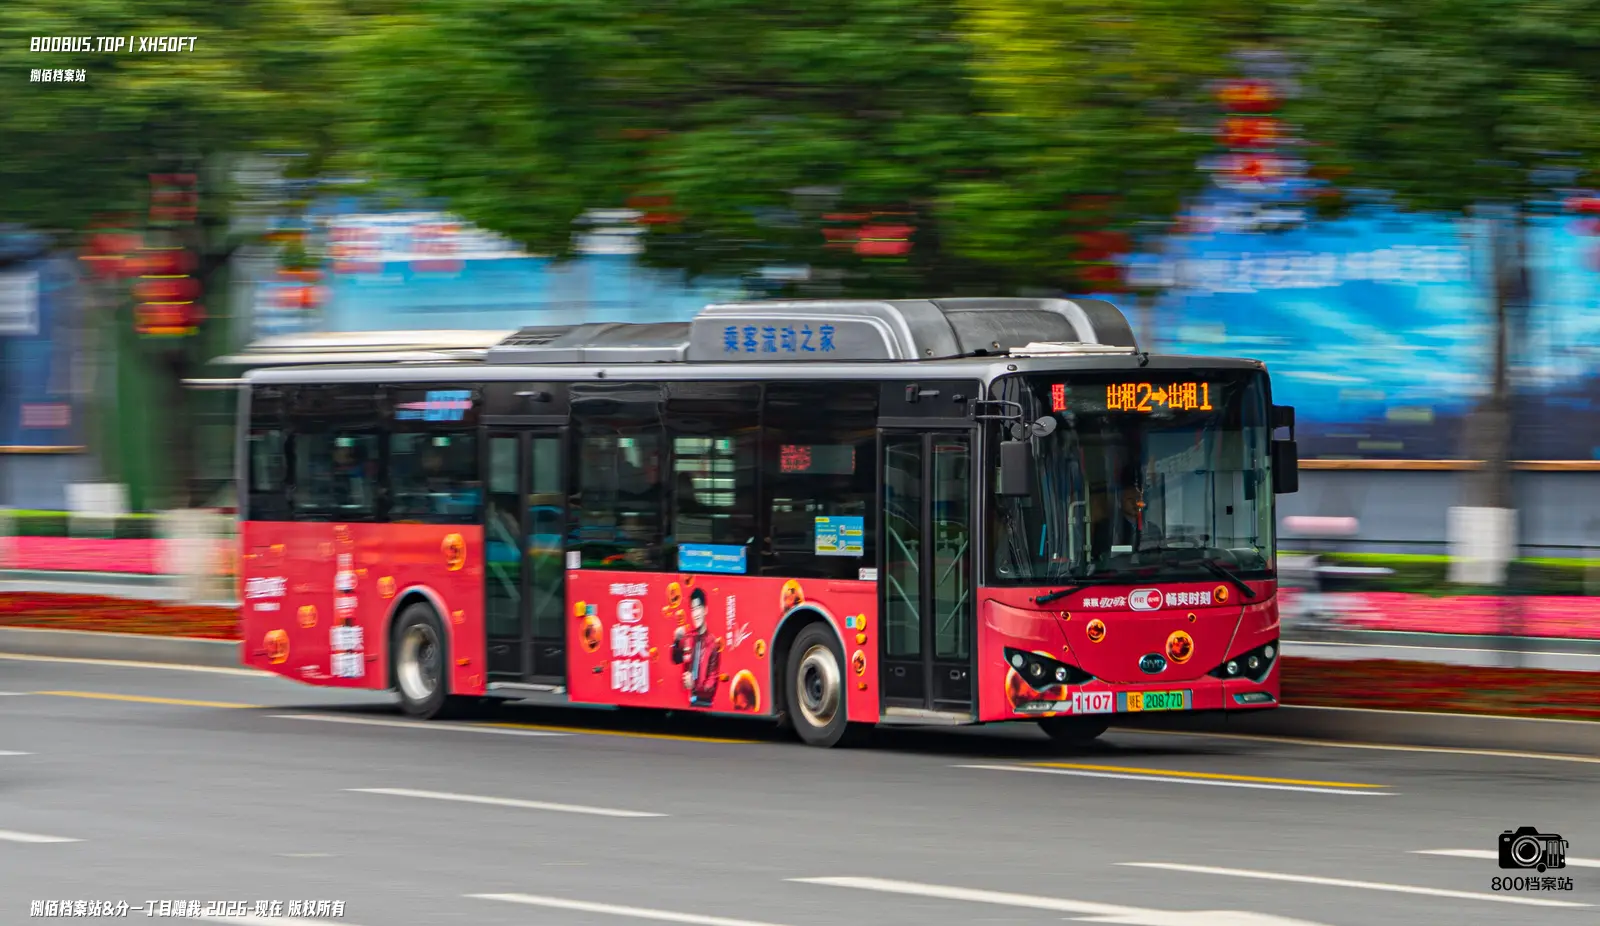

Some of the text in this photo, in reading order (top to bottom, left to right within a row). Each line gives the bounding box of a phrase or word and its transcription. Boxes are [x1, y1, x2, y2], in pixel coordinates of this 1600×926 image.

[723, 324, 836, 353] 乘客流动之家
[1165, 591, 1211, 607] 畅爽时刻
[1075, 694, 1111, 710] 1107
